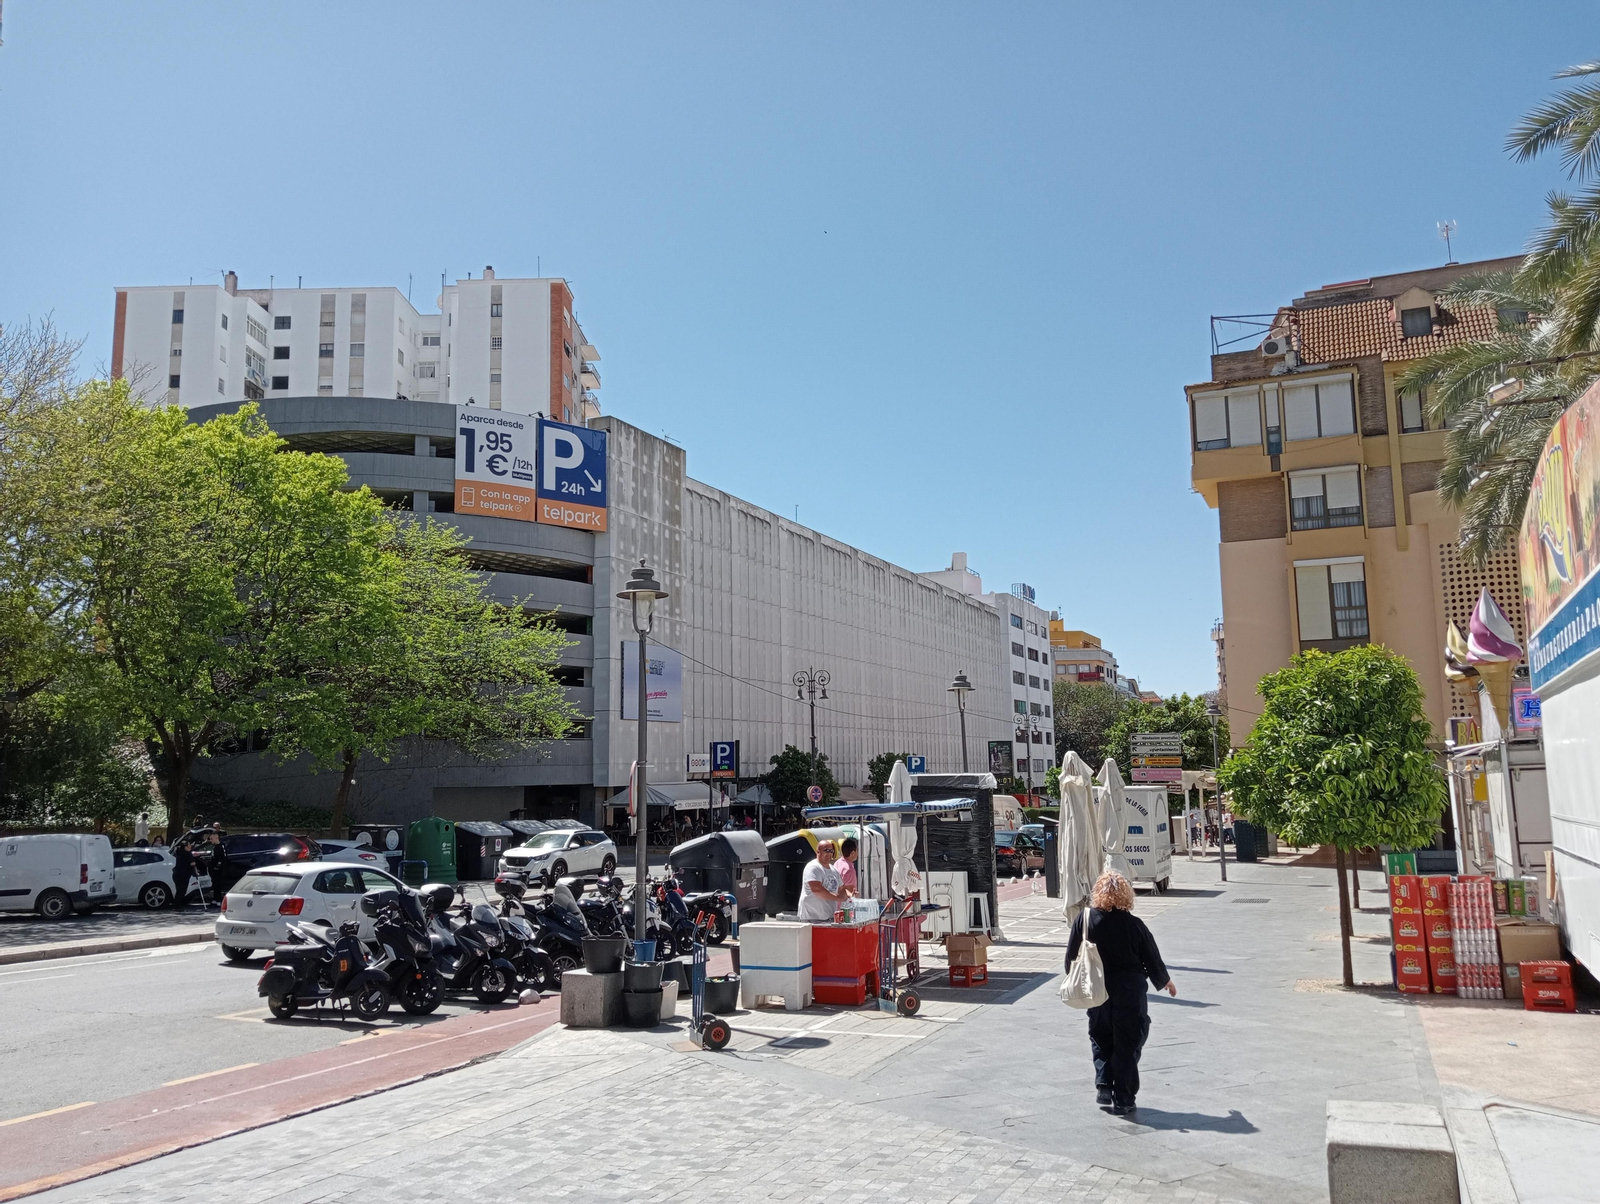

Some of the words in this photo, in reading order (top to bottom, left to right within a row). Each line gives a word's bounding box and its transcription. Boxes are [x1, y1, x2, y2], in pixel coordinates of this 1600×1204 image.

[460, 413, 495, 425] Aparca
[497, 418, 524, 430] desde
[544, 426, 585, 491] P
[561, 481, 585, 496] 24h
[480, 489, 500, 499] Con
[502, 490, 511, 500] la
[512, 493, 530, 504] app
[480, 500, 514, 512] telpark
[544, 504, 601, 526] telpark
[716, 744, 730, 764] P
[912, 758, 921, 770] P
[1136, 803, 1149, 817] FERIA
